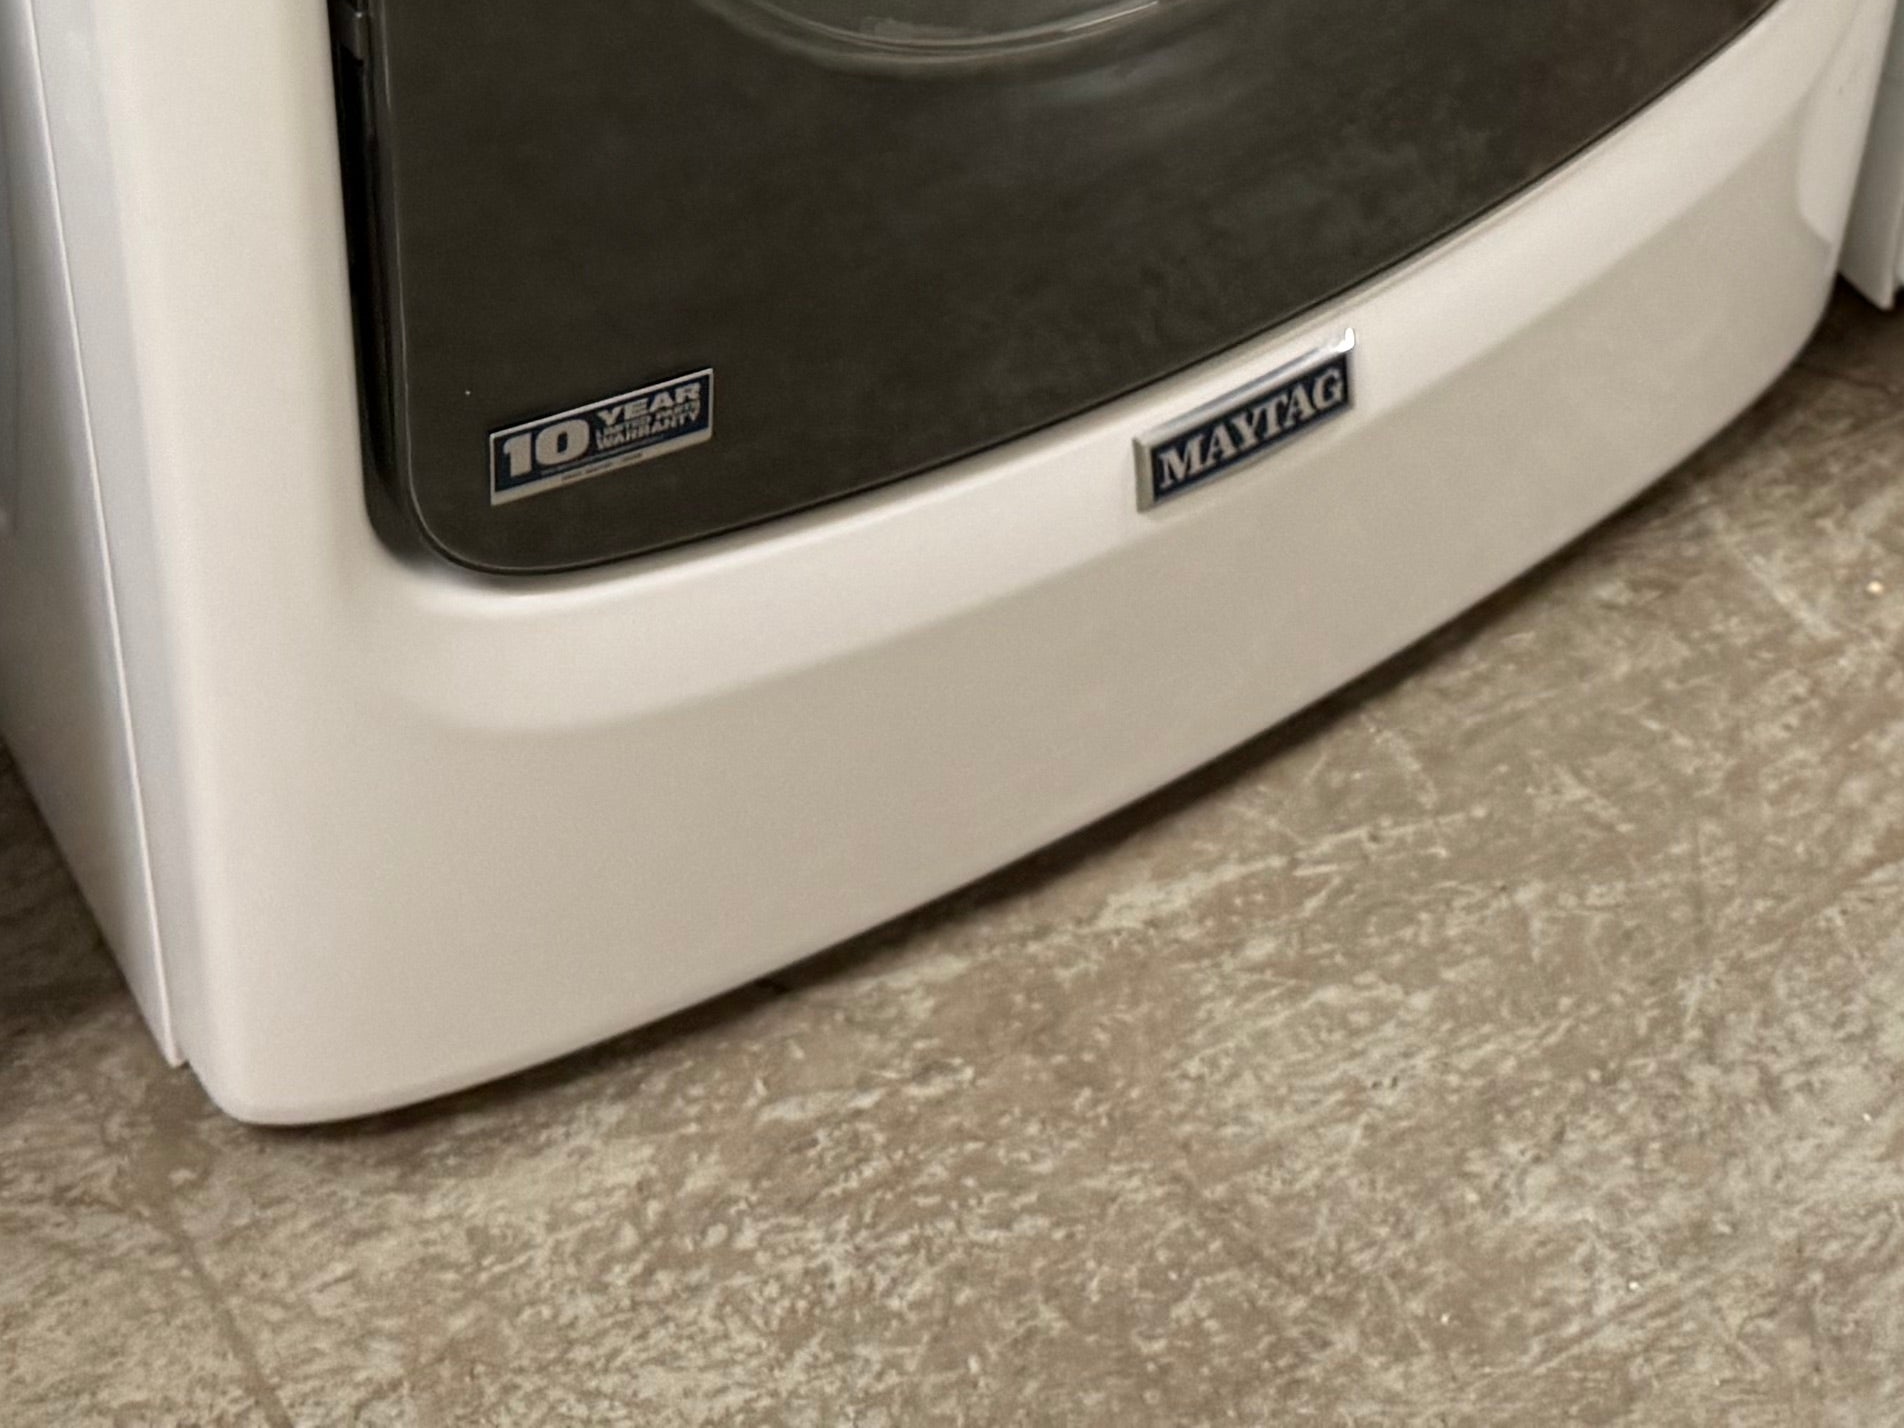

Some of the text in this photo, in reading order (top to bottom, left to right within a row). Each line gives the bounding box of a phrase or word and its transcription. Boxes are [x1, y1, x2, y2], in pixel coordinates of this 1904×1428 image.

[502, 418, 591, 478] 10
[597, 381, 701, 426] YEAR
[596, 404, 701, 451] WARRANTY
[1155, 365, 1346, 491] MAYTAG
